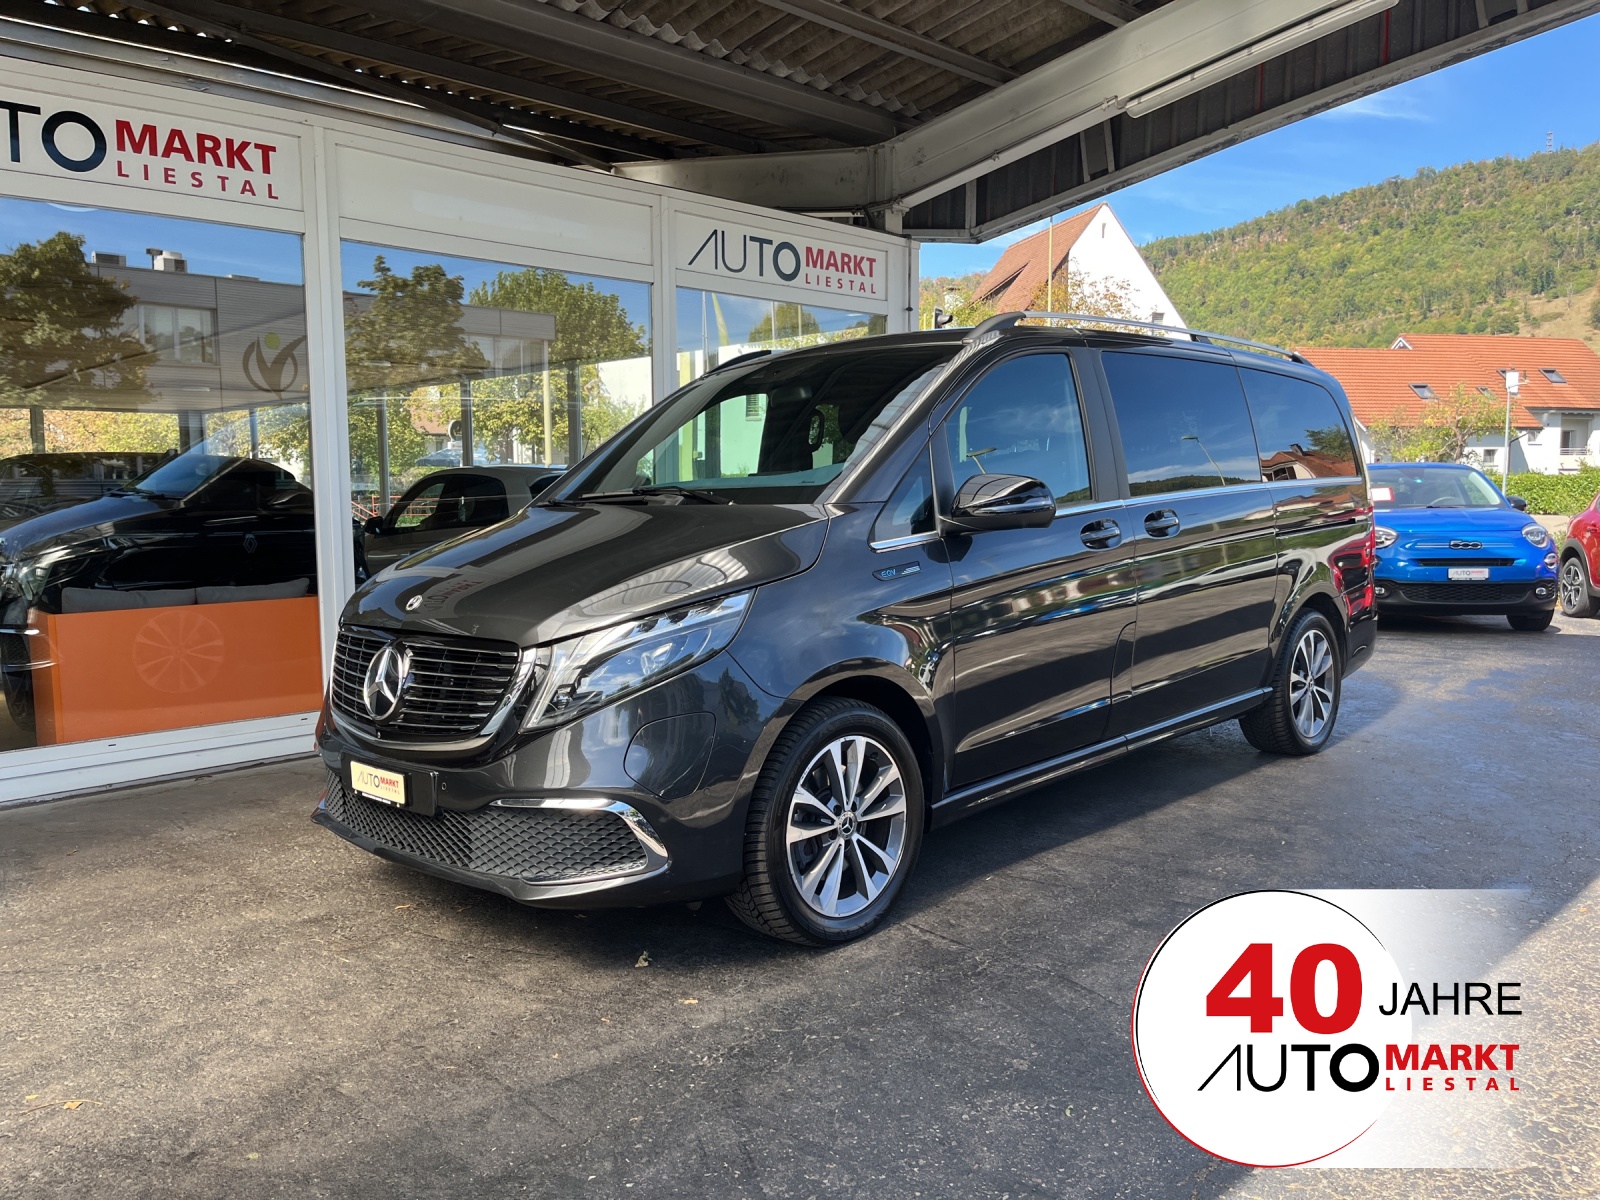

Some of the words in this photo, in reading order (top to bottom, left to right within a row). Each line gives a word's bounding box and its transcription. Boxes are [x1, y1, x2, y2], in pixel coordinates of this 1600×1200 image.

[115, 119, 276, 175] MARKT
[117, 160, 279, 200] LIESTAL
[688, 229, 801, 282] AUTO
[805, 246, 876, 278] MARKT
[805, 273, 876, 294] LIESTAL
[358, 771, 380, 788] AUTO
[380, 777, 399, 788] MARKT
